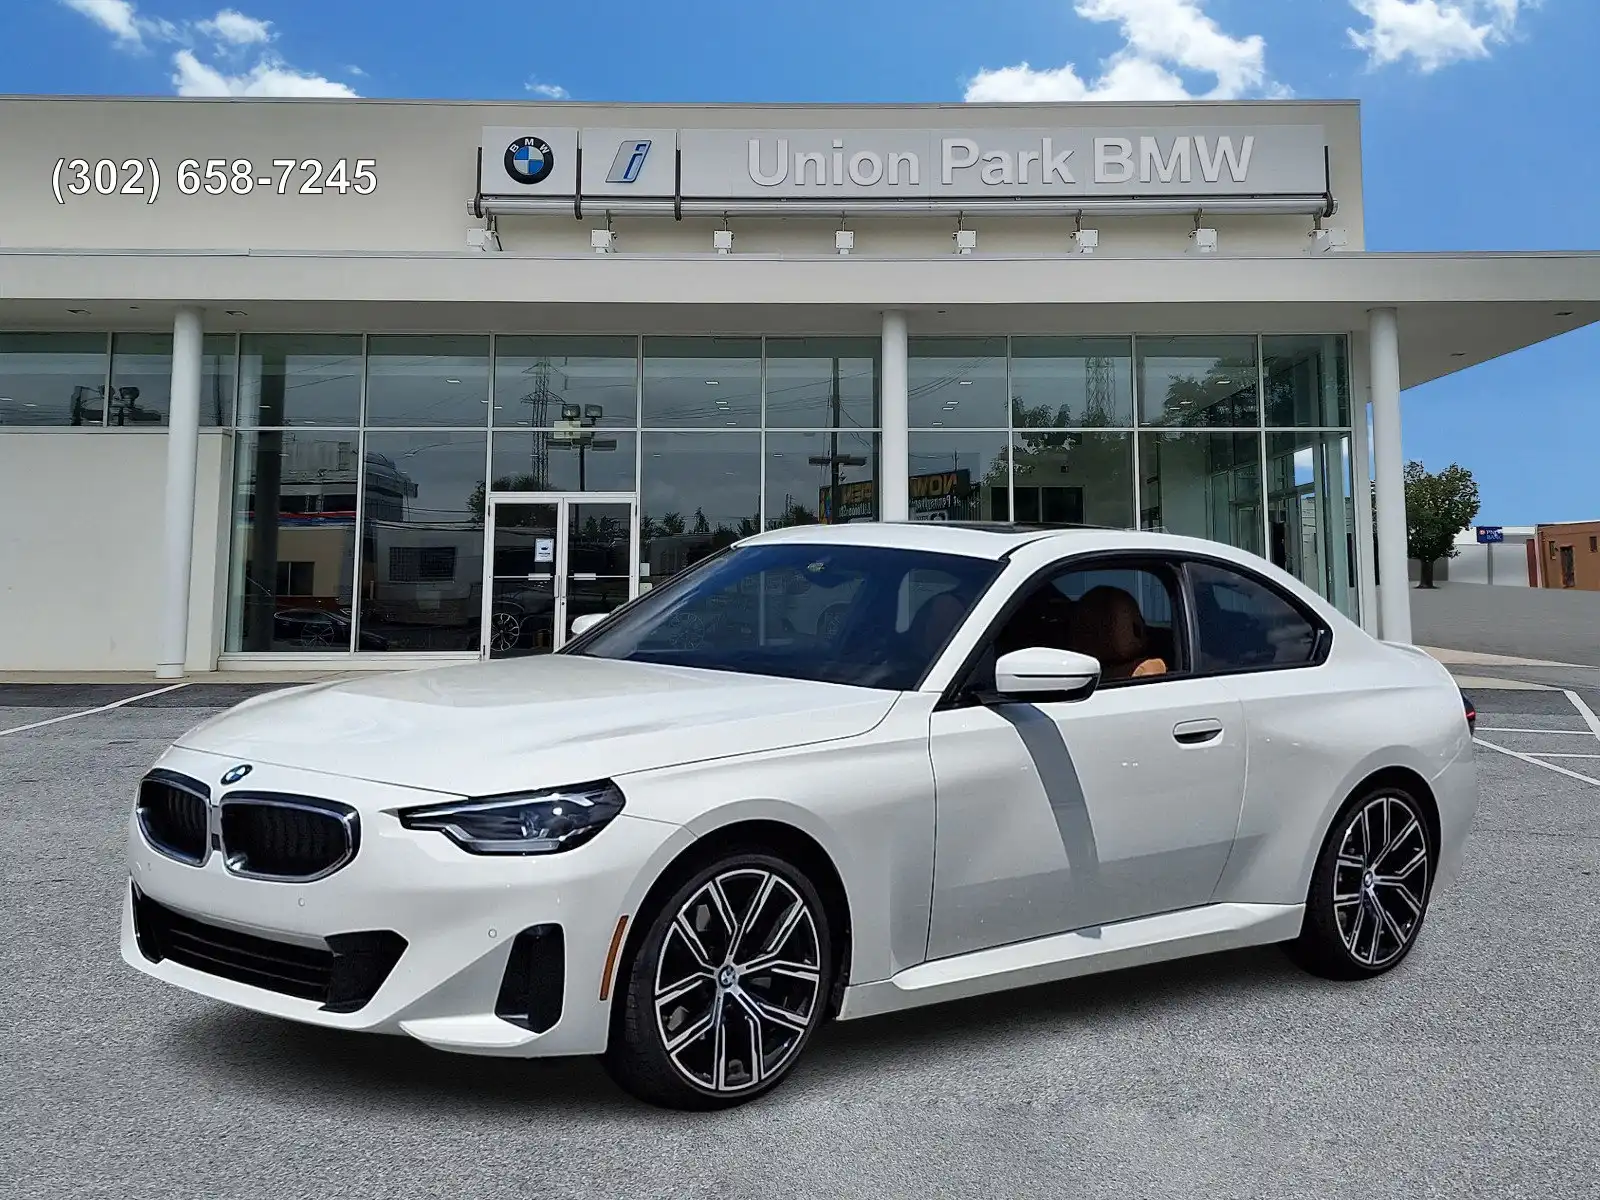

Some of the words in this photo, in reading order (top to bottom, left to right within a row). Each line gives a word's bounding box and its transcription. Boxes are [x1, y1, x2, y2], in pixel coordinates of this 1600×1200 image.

[748, 139, 920, 187] Union
[941, 138, 1077, 186] Park
[1093, 136, 1255, 184] BMW
